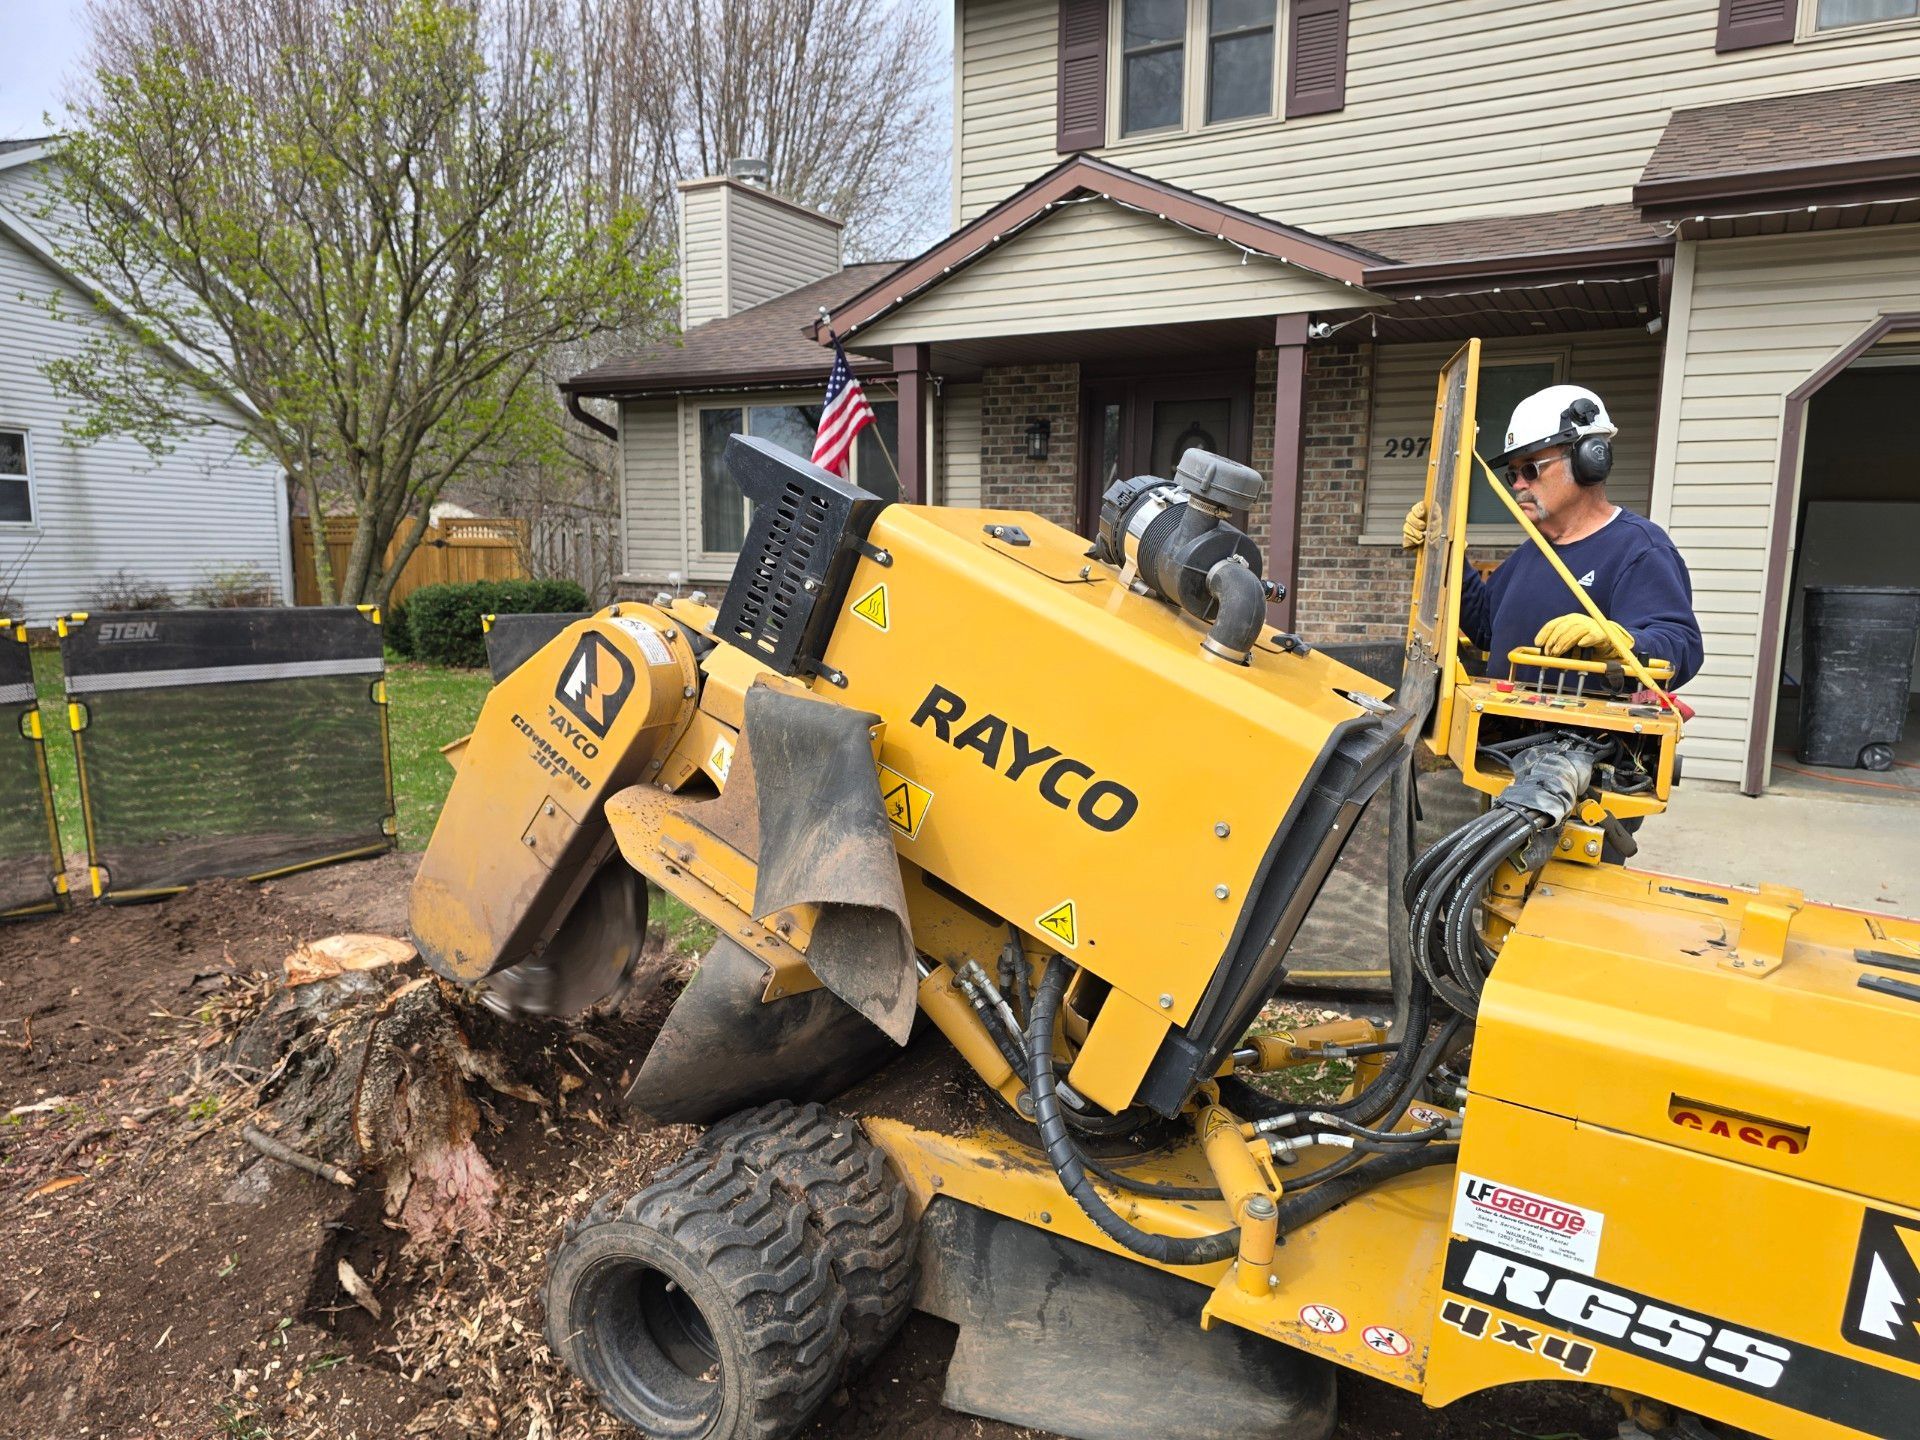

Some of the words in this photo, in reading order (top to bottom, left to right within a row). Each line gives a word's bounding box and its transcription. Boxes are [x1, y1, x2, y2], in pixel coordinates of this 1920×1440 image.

[1384, 437, 1430, 458] 297
[98, 621, 157, 640] STEIN
[511, 714, 591, 790] COMMAND
[910, 683, 1138, 832] RAYCO
[1673, 1111, 1807, 1154] GASO
[1475, 1206, 1493, 1215] Under
[1499, 1213, 1517, 1223] Above
[1517, 1219, 1540, 1230] Ground
[1540, 1226, 1572, 1240] Equipment
[1478, 1214, 1493, 1223] Sales
[1500, 1221, 1521, 1232] Service
[1528, 1230, 1543, 1239] Parts
[1550, 1236, 1569, 1247] Rental
[1505, 1229, 1538, 1243] WAUKESHA
